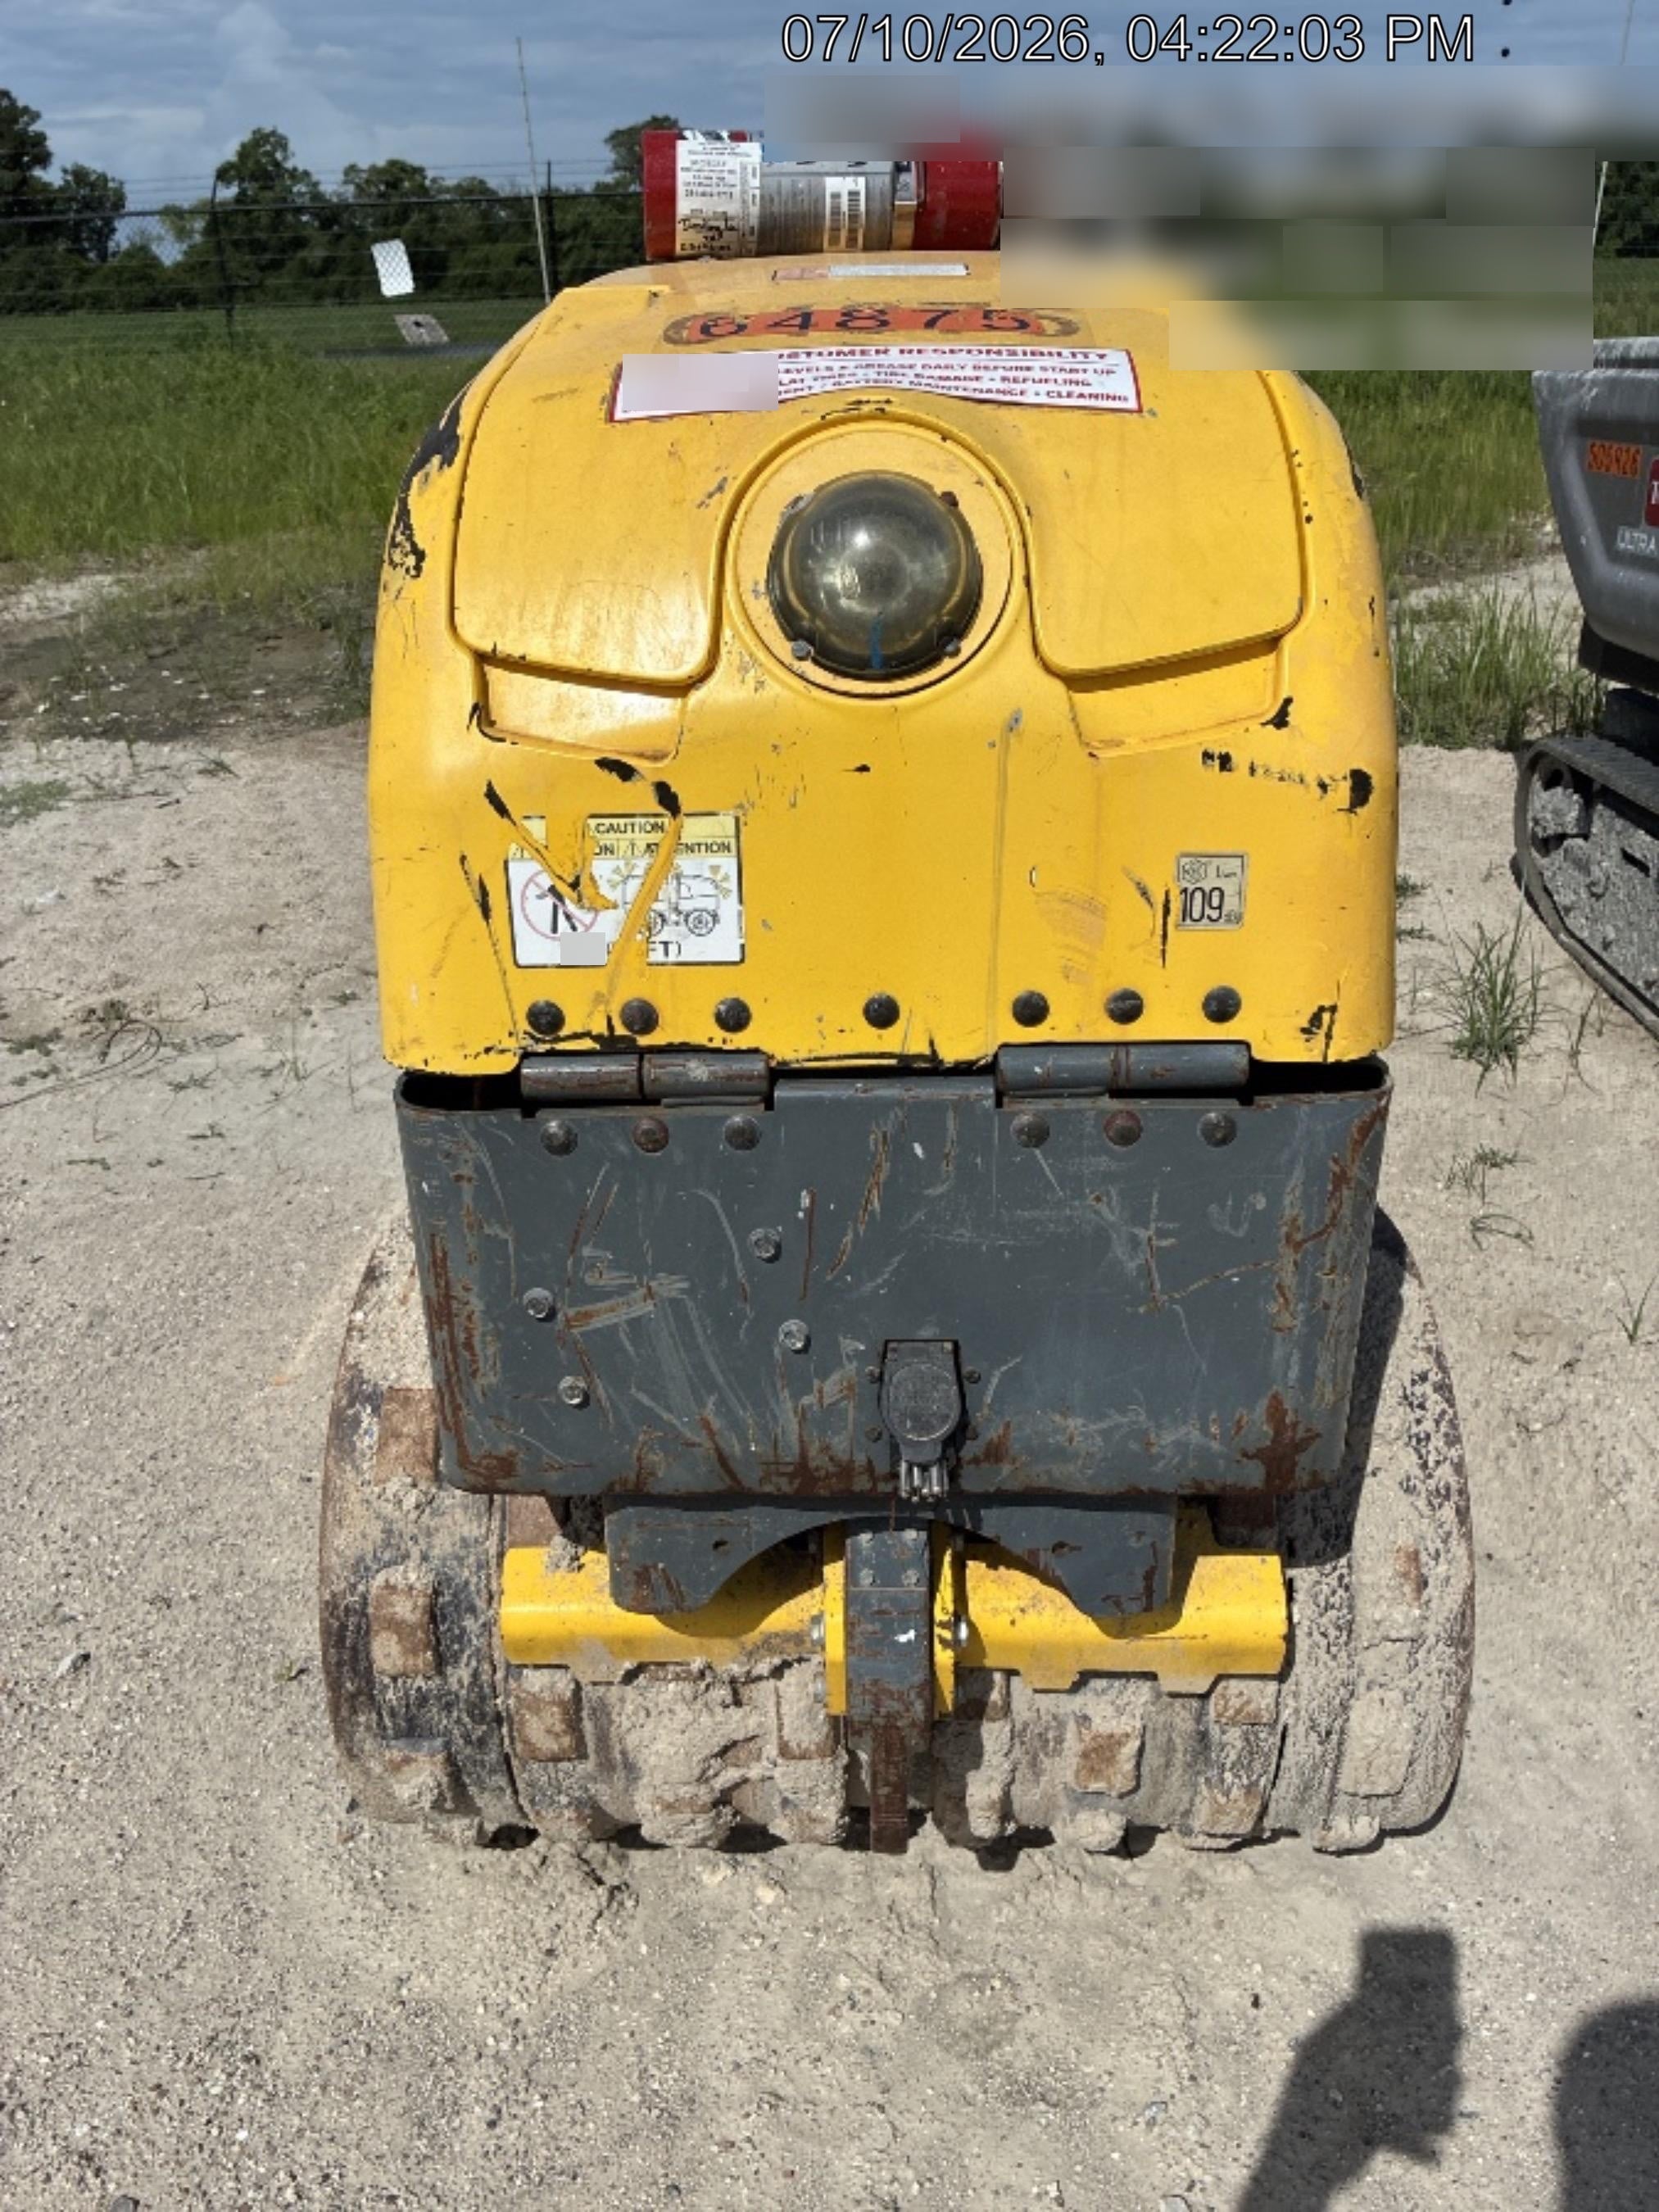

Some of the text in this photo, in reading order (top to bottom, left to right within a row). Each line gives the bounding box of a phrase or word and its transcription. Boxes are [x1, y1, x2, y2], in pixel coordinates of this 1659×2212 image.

[700, 307, 1031, 338] 64875
[778, 347, 1108, 360] STOMER RESPONSIBILITY
[778, 365, 834, 374] EVELS
[972, 364, 1036, 372] BEFORE
[1040, 365, 1090, 374] START
[1093, 368, 1117, 376] UP
[778, 378, 805, 387] LAT
[999, 375, 1093, 388] REFUELING
[1046, 389, 1130, 403] CLEANING
[595, 820, 665, 834] CAUTION
[1180, 887, 1224, 922] 109
